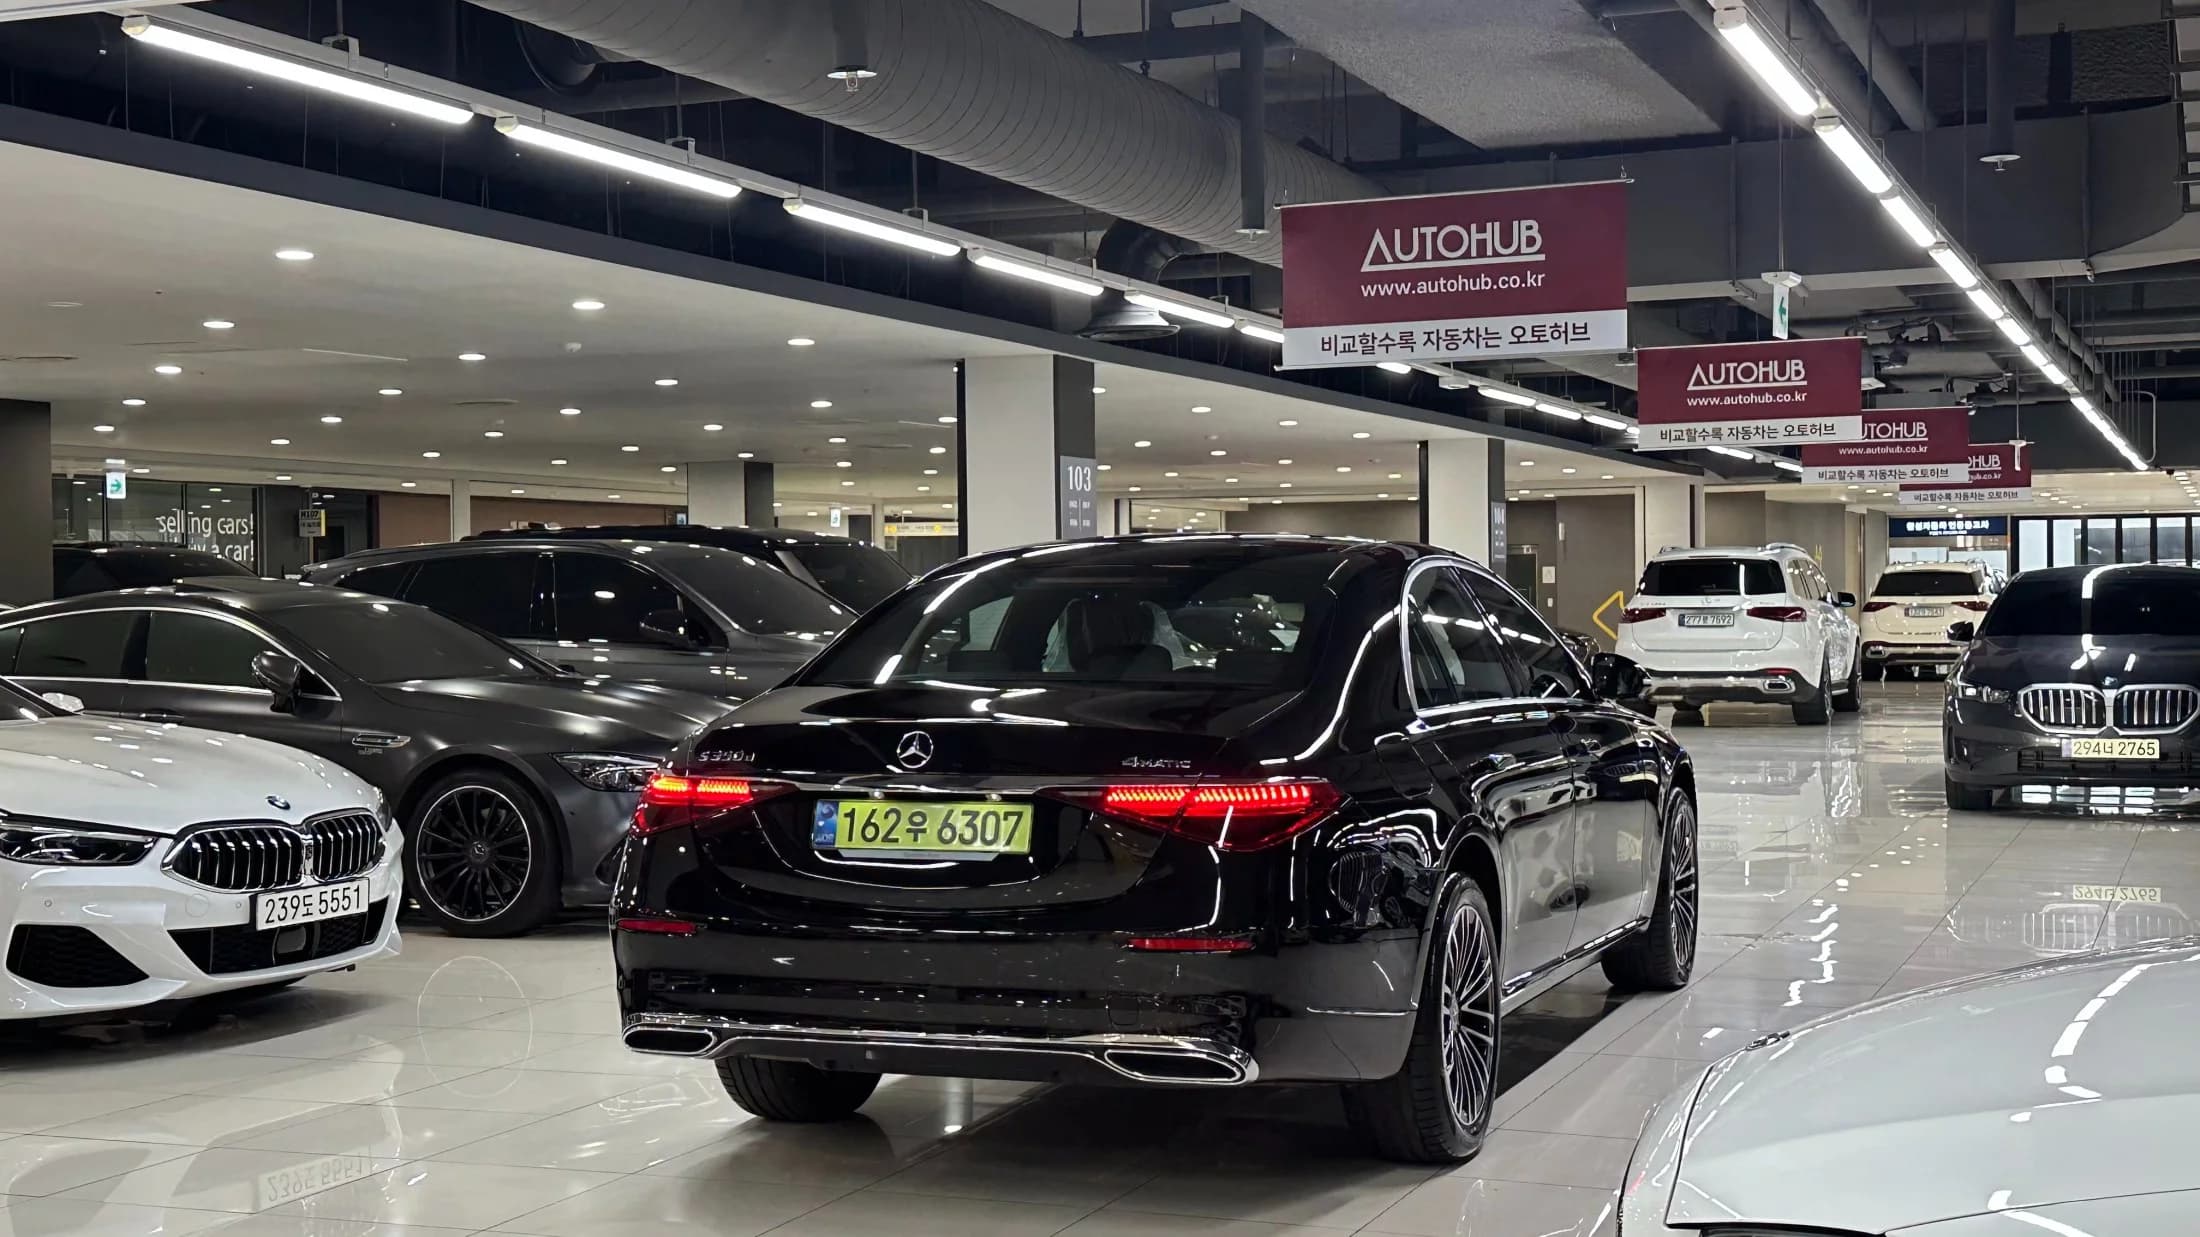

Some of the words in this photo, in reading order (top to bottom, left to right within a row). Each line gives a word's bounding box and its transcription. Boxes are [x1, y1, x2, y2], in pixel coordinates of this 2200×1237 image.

[1361, 219, 1545, 272] AUTOHUB
[1361, 270, 1545, 297] www.autohub.co.kr
[1321, 330, 1416, 357] 비교할수록
[1422, 326, 1502, 350] 자동차는
[1508, 321, 1591, 345] 오토허브
[1687, 359, 1808, 391] AUTOHUB
[1687, 391, 1807, 407] www.autohub.co.kr
[1660, 427, 1723, 443] 비교할수록
[1727, 424, 1779, 441] 자동차는
[1783, 423, 1837, 437] 오토허브
[1862, 422, 1928, 440] TOHUB
[1068, 466, 1091, 492] 103
[159, 509, 212, 538] selling
[217, 513, 254, 535] cars!
[225, 540, 254, 562] car!
[2073, 741, 2113, 756] 294너
[2118, 741, 2156, 756] 2765
[843, 808, 928, 843] 162우
[937, 809, 1024, 847] 6307
[265, 894, 313, 923] 239도
[318, 885, 360, 915] 5551
